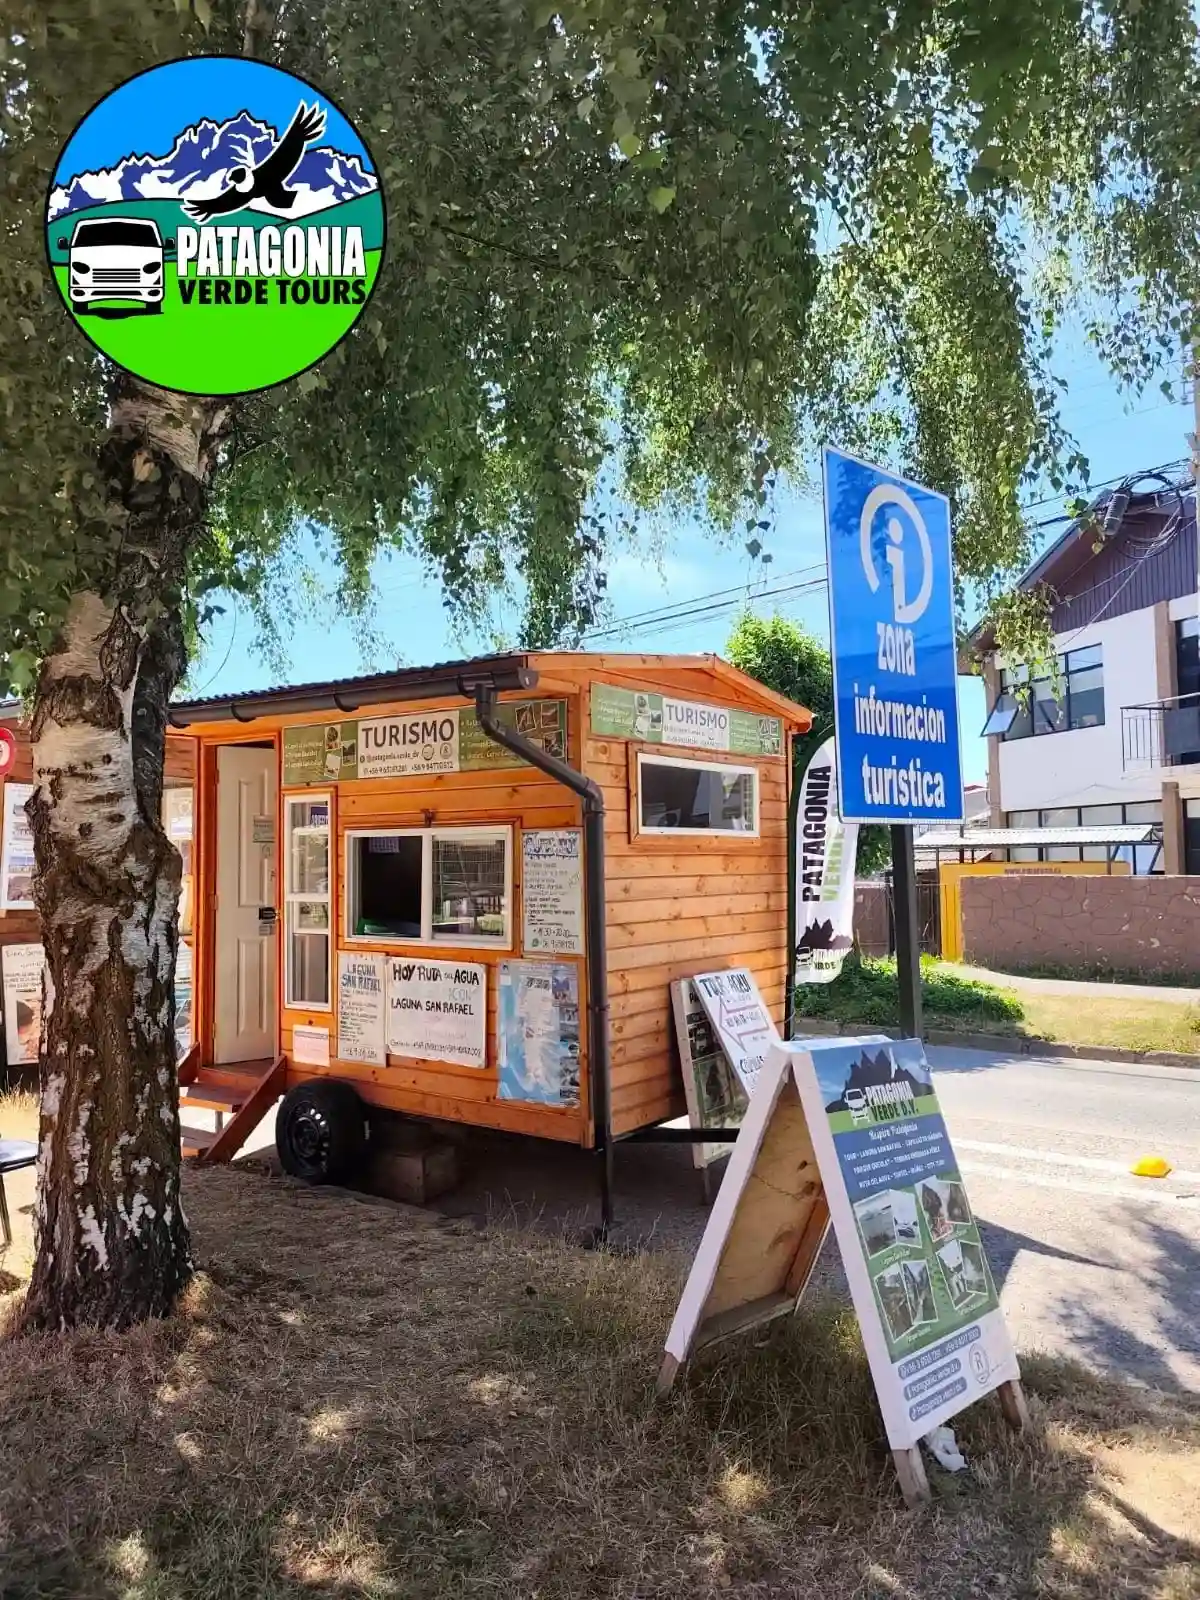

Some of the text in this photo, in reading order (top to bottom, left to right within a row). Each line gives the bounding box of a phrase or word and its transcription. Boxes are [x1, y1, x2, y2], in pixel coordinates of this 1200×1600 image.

[876, 621, 916, 676] zona
[666, 704, 727, 729] TURISMO
[854, 682, 946, 743] informacion
[361, 718, 454, 748] TURISMO
[862, 753, 945, 808] turistica
[802, 766, 831, 902] PATAGONIA
[342, 974, 356, 988] SAN
[347, 963, 376, 977] LAGUNA
[393, 963, 416, 981] HOY
[417, 965, 442, 981] RUTA
[454, 968, 479, 985] AGUA
[391, 998, 474, 1015] LAGUNA SAN RAFAEL
[865, 1080, 914, 1106] PATAGONIA
[871, 1101, 900, 1121] VERDE
